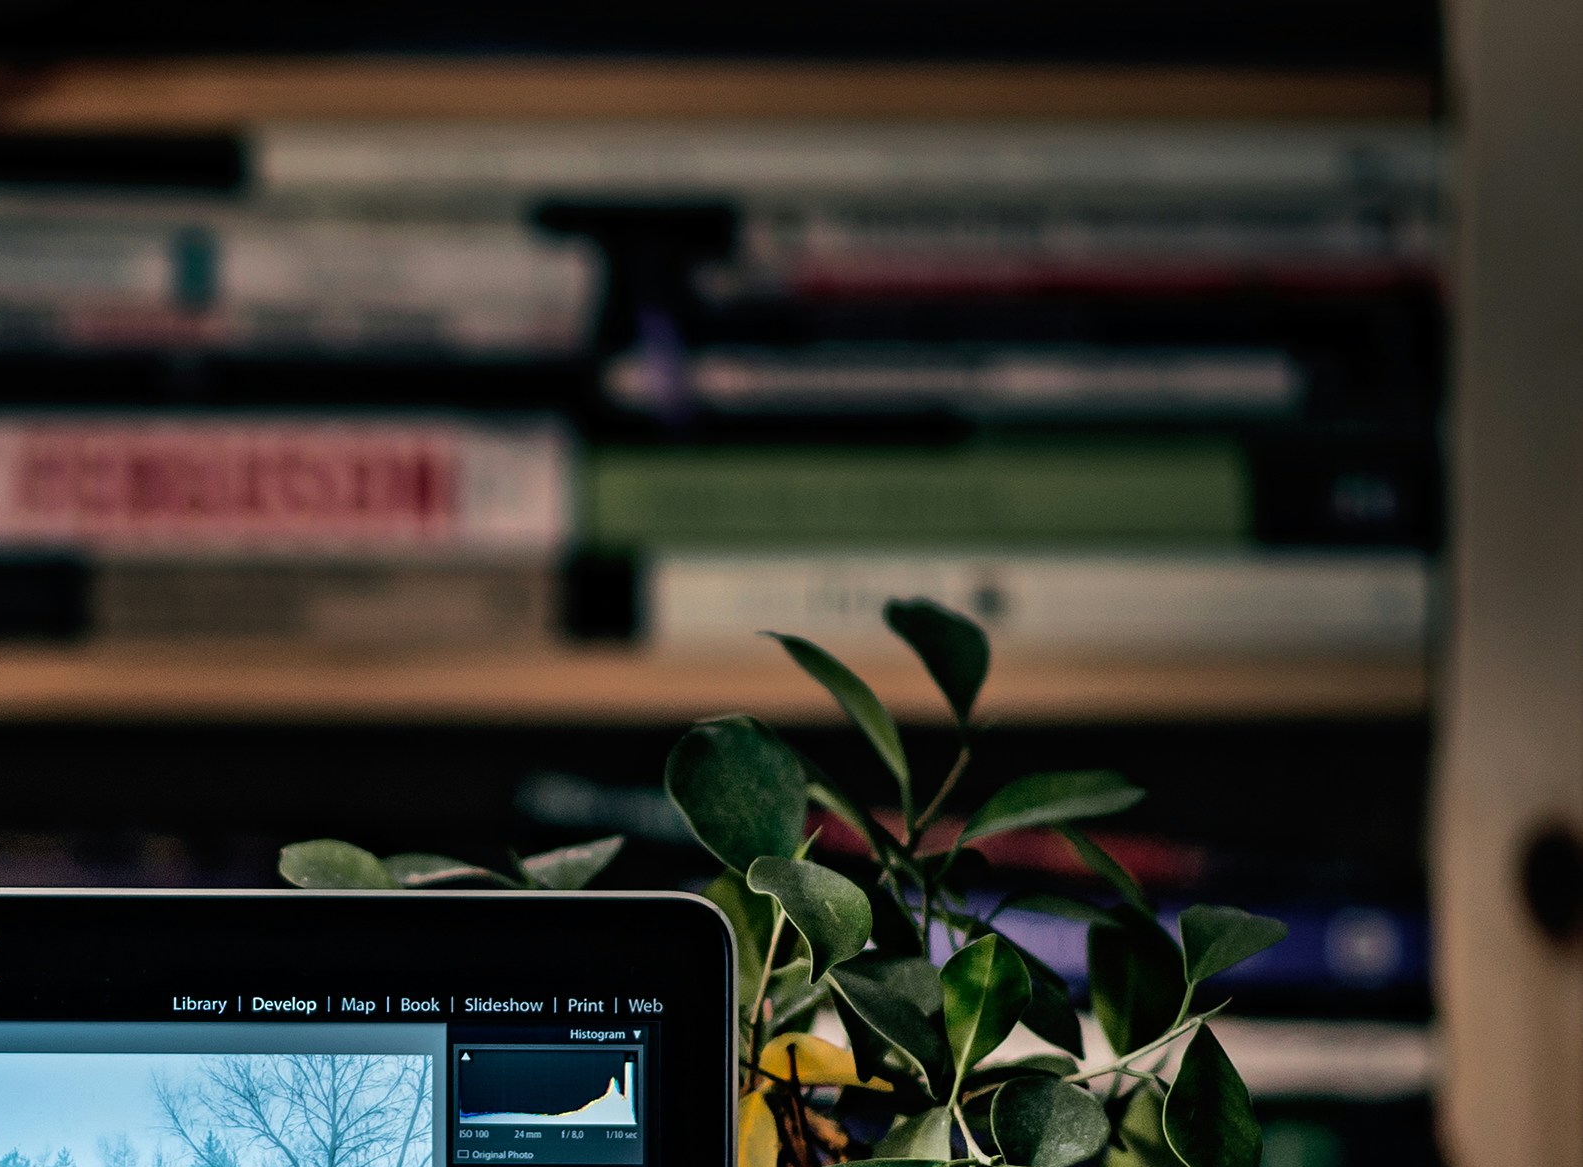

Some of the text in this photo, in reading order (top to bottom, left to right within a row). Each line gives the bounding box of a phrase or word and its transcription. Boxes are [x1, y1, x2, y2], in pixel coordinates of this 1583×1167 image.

[174, 996, 228, 1014] Library
[253, 996, 317, 1014] Develop
[342, 997, 376, 1014] Map
[401, 996, 441, 1011] Book
[465, 997, 544, 1011] Slideshow
[569, 998, 605, 1012] Print
[629, 997, 664, 1012] Web
[570, 1028, 626, 1041] Histogram
[459, 1129, 490, 1138] ISO 100
[515, 1129, 525, 1138] 24
[607, 1130, 624, 1138] 1/10
[472, 1150, 535, 1160] Original Photo
